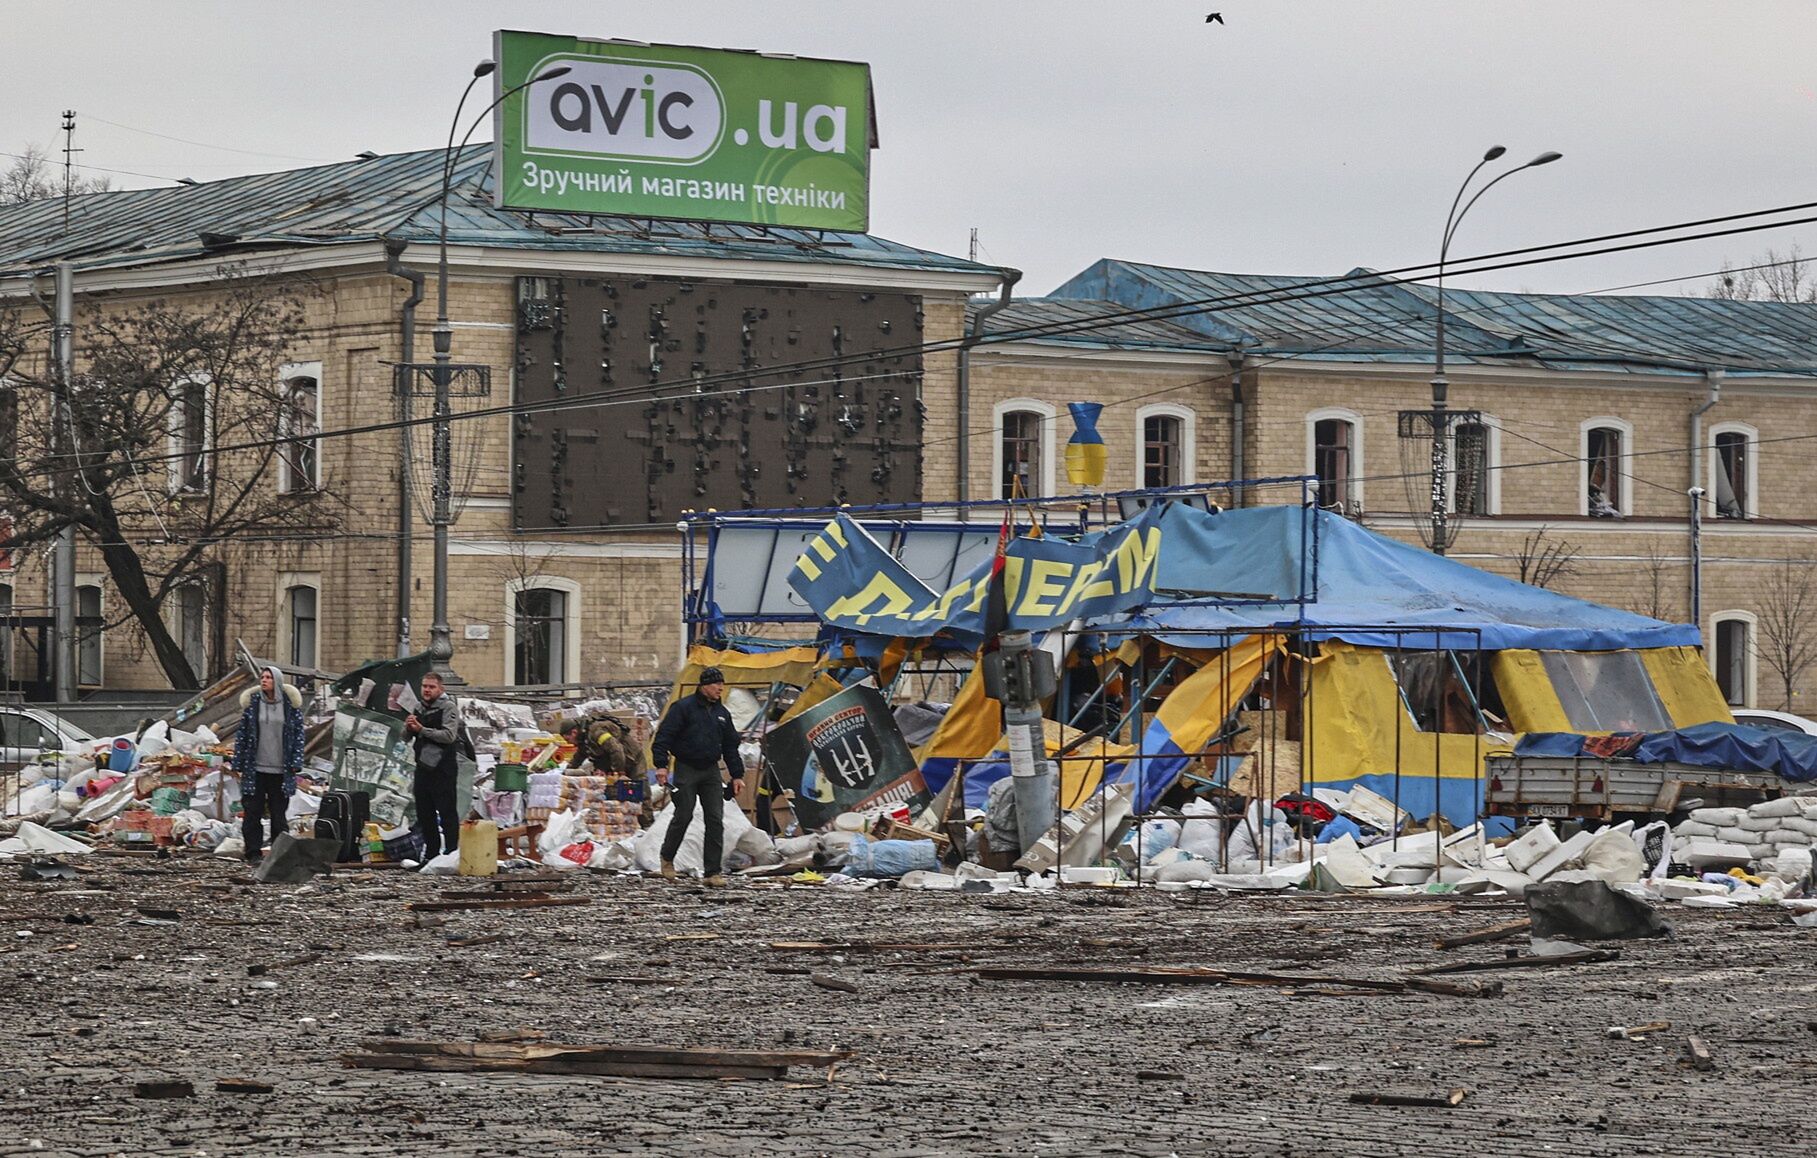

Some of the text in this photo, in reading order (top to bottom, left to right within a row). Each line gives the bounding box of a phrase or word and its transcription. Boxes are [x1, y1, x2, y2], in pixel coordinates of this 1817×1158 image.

[550, 73, 694, 140] avic
[522, 161, 846, 210] Зручний магазин техніки
